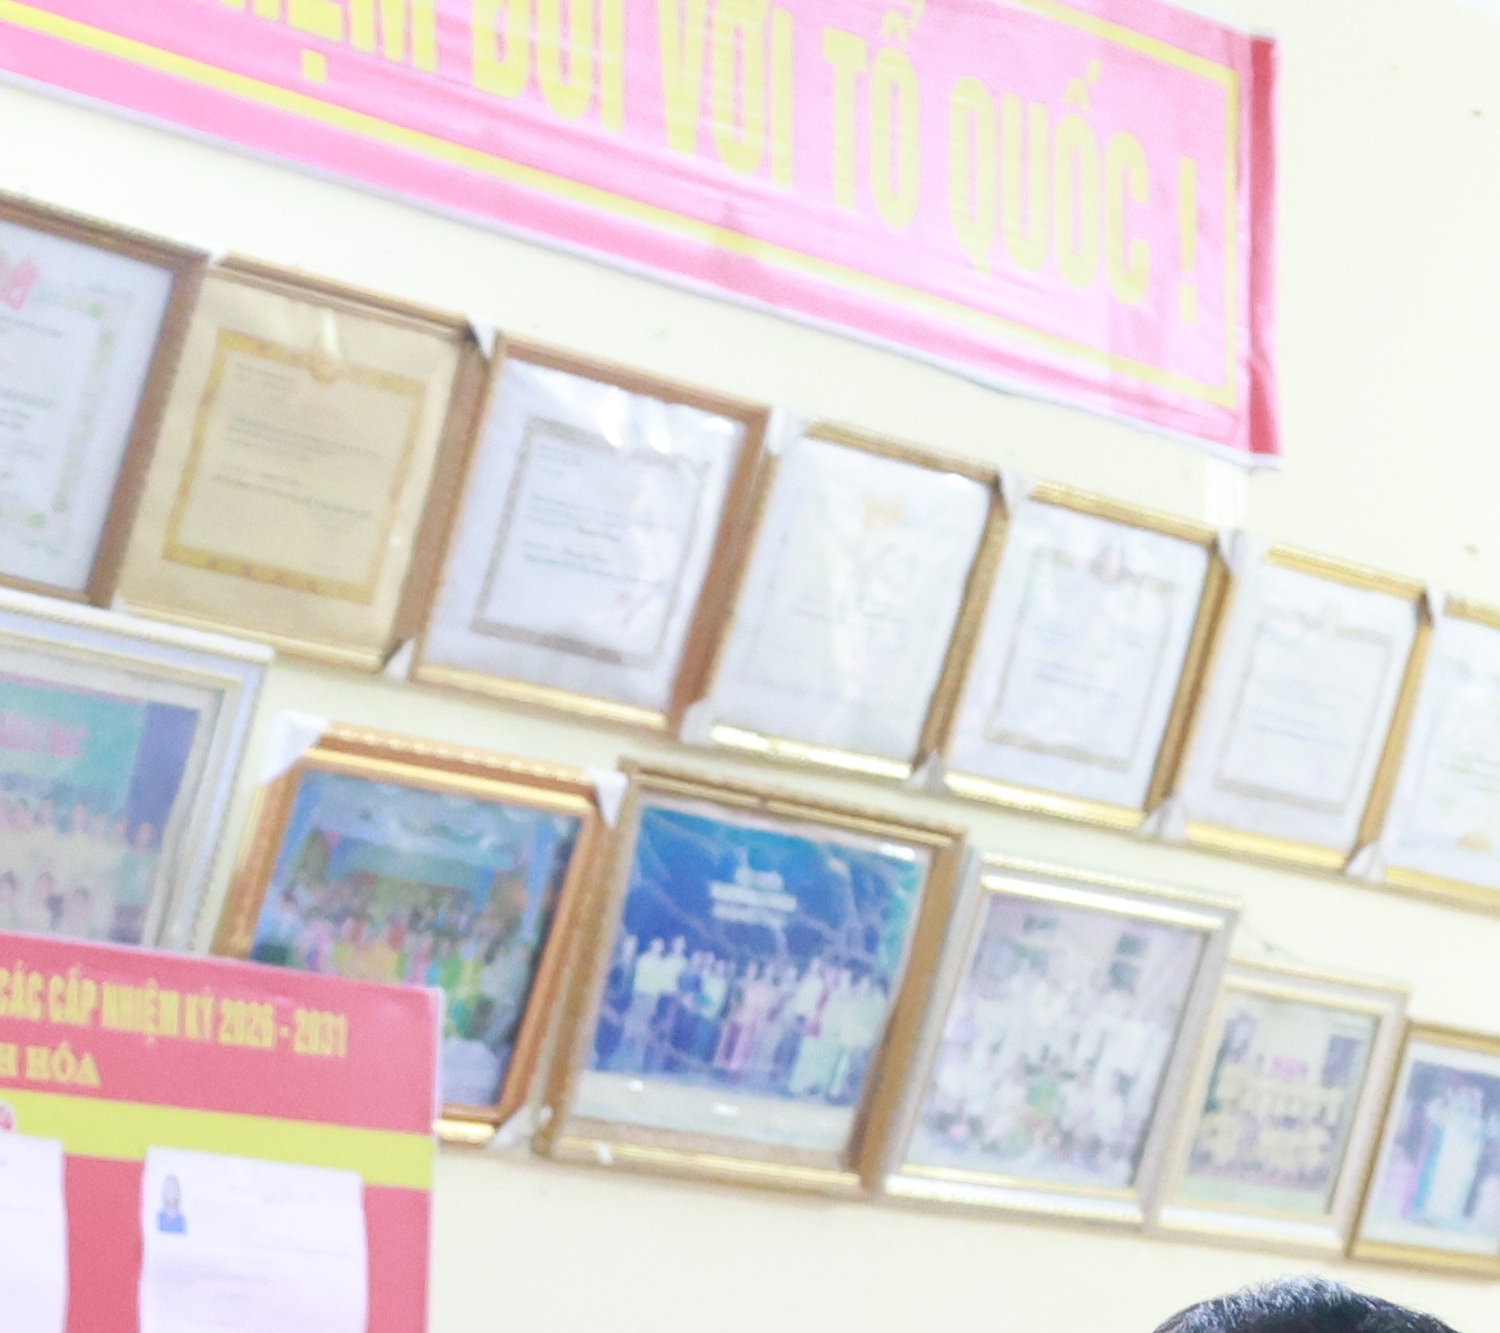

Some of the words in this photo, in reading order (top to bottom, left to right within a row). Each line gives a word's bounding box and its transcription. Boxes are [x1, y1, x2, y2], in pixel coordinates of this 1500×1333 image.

[949, 59, 1150, 306] QUỐC
[219, 998, 275, 1051] 2026
[293, 1008, 348, 1058] 2031
[25, 1040, 100, 1087] HÓA
